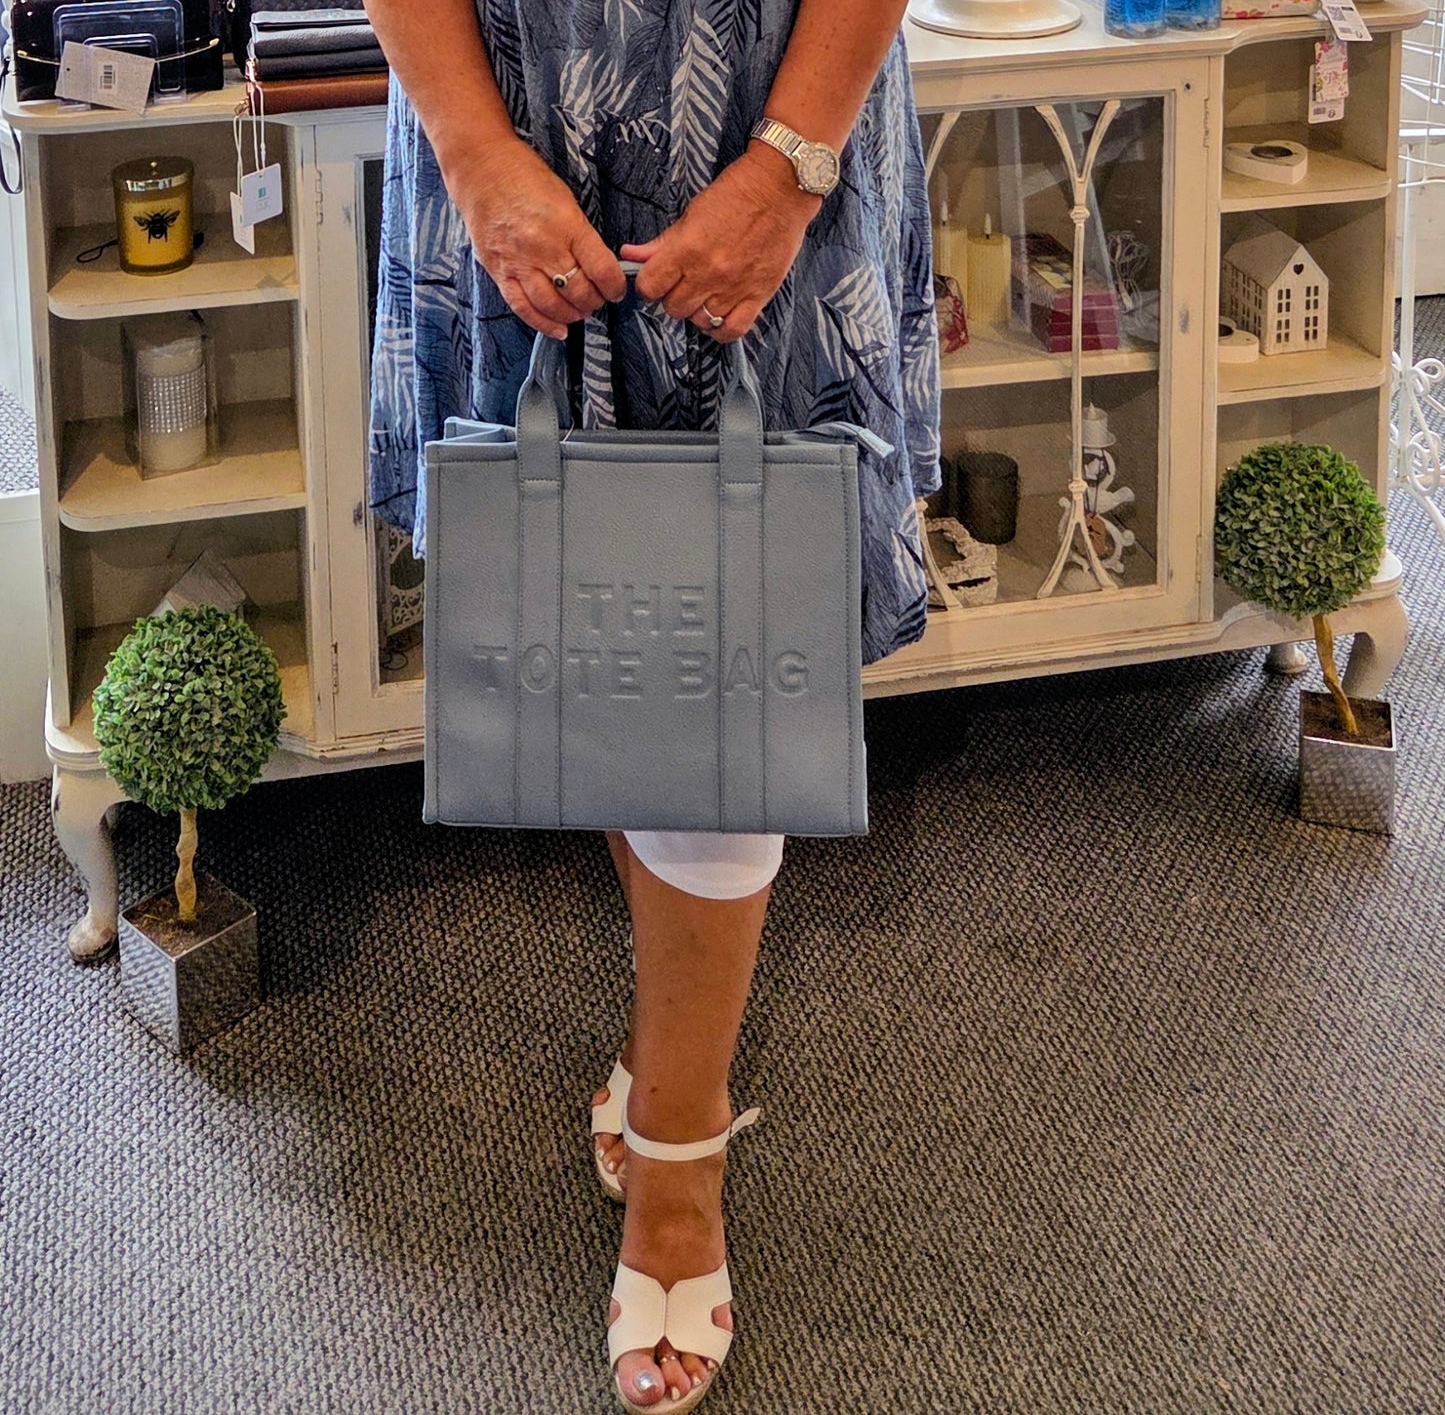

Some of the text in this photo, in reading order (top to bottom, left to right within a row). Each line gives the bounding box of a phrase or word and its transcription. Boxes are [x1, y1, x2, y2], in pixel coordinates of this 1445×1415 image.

[577, 584, 705, 636] THE
[473, 643, 809, 699] TOTE BAG
